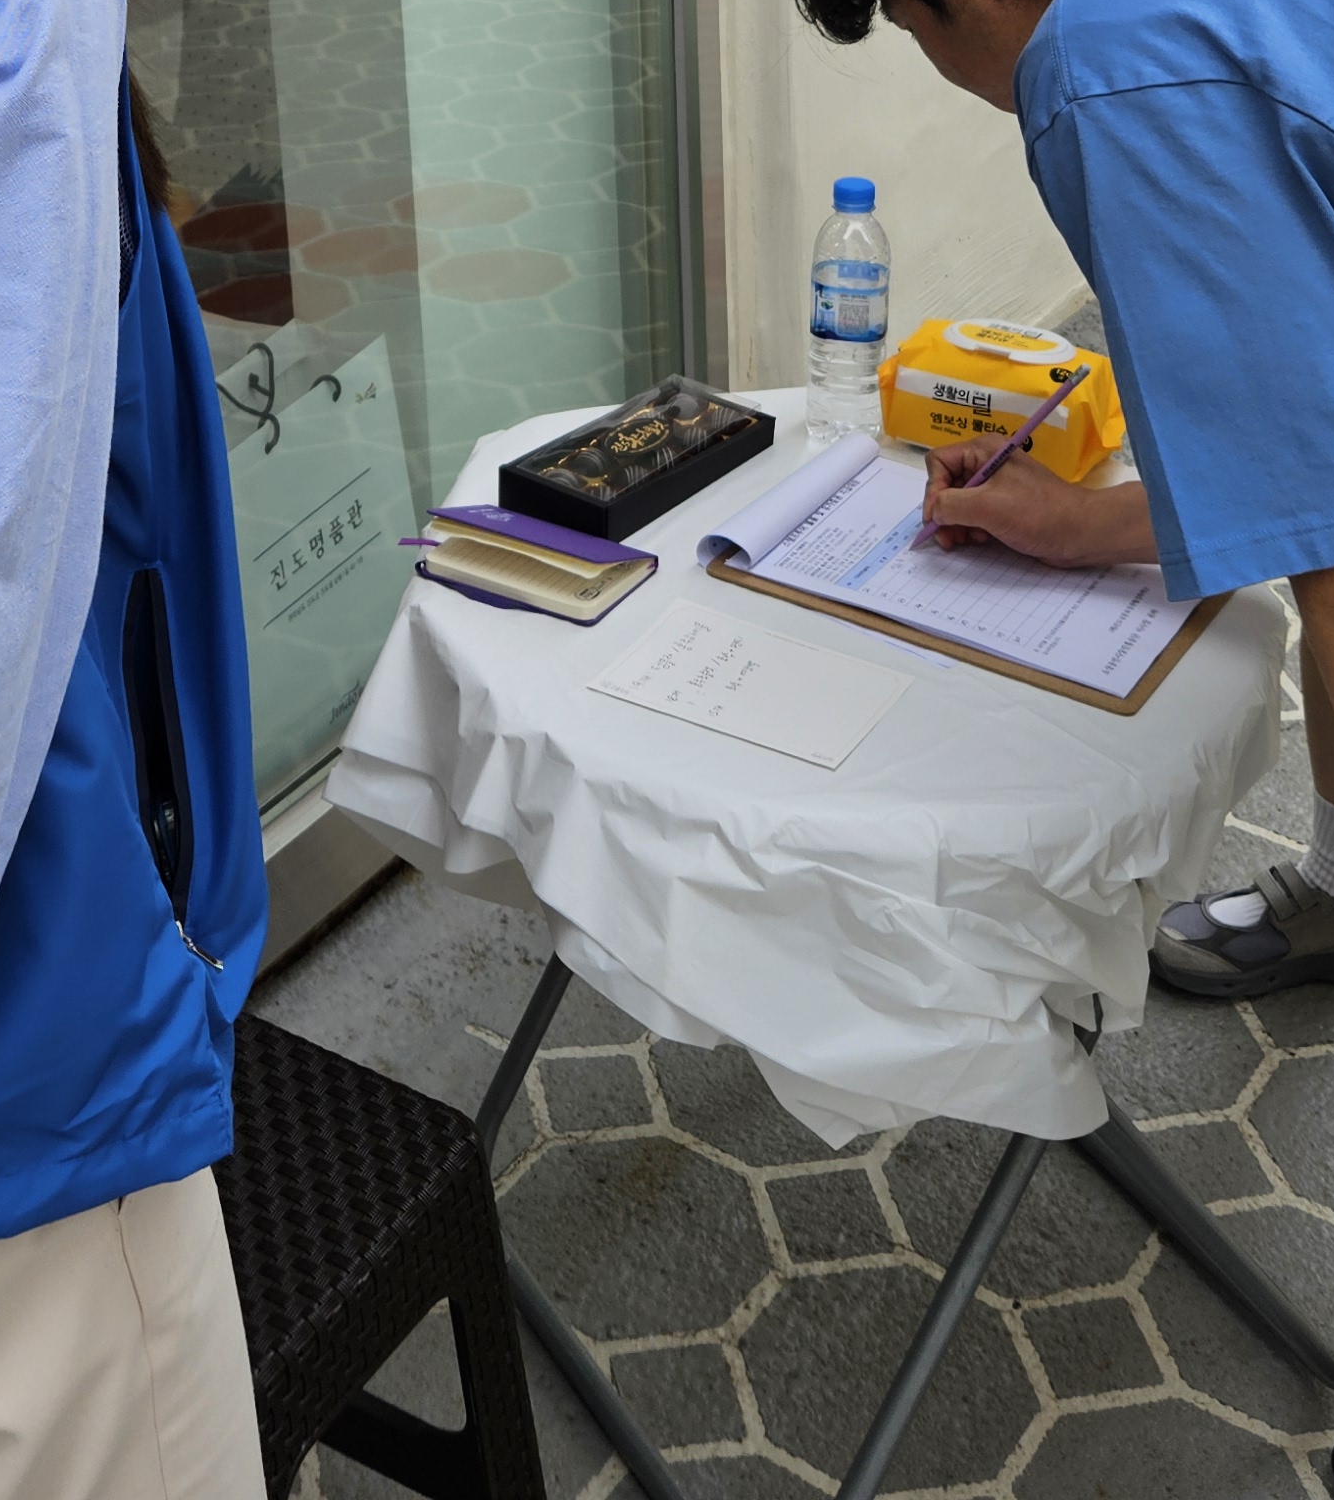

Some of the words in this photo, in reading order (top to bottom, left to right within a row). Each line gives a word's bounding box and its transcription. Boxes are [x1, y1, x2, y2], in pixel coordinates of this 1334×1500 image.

[933, 383, 970, 404] 생활의
[971, 393, 992, 417] 딜
[930, 412, 967, 430] 엠보싱
[271, 499, 363, 591] 진도명품관
